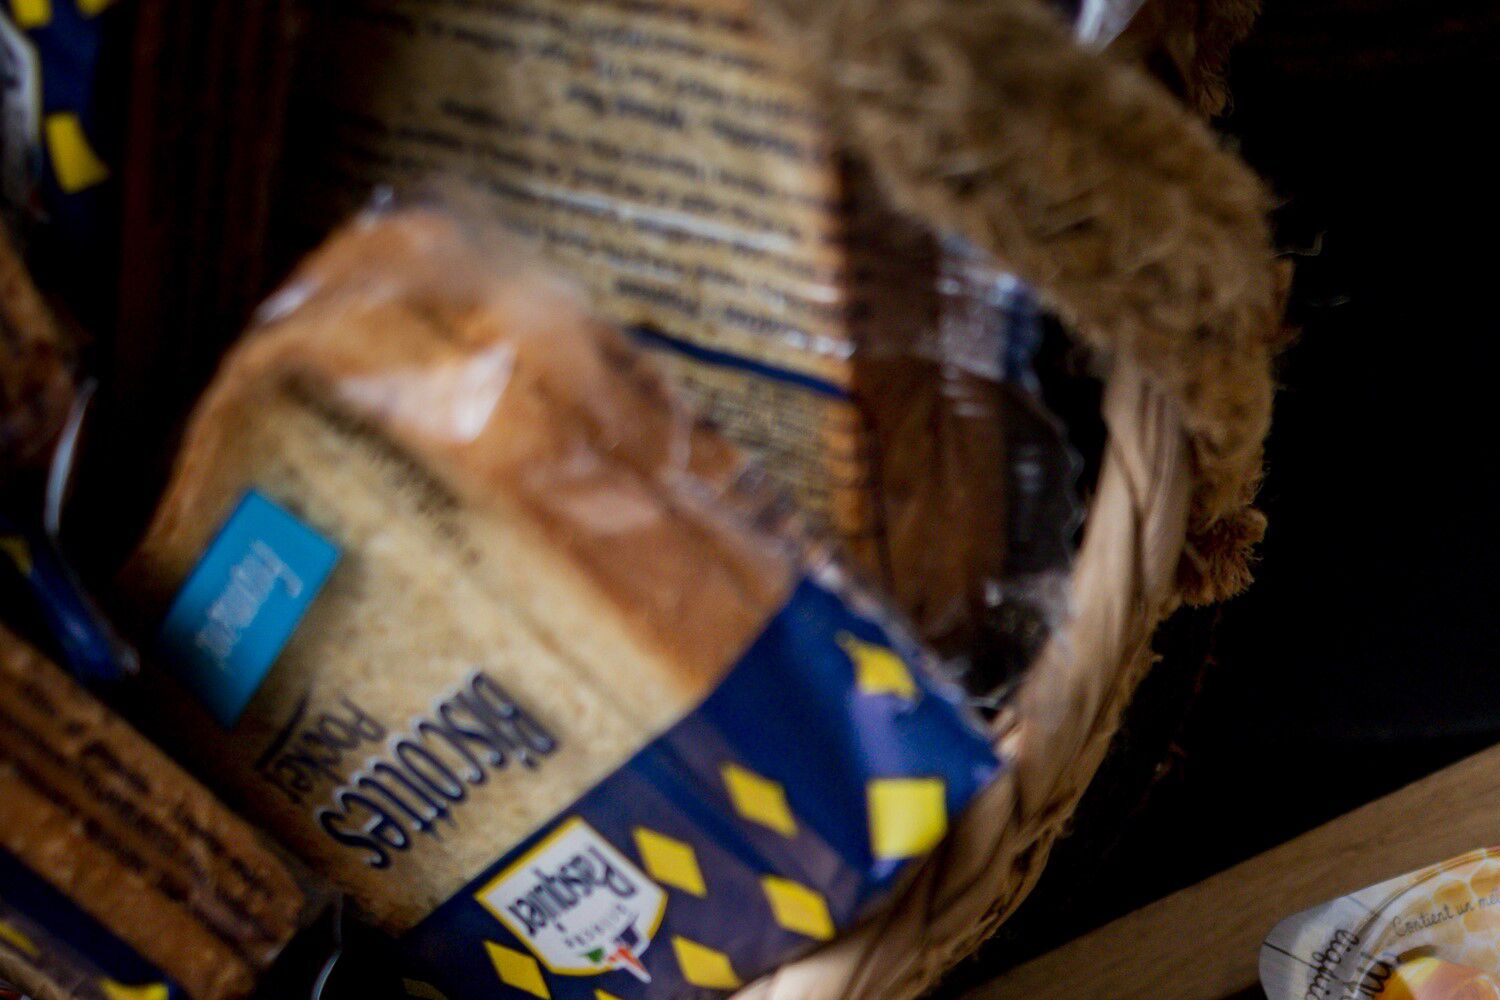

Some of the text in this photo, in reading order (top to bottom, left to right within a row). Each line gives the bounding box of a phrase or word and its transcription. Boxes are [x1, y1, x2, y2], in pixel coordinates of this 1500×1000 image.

[316, 668, 559, 869] Biscottes
[507, 844, 638, 935] Pasquier
[1393, 905, 1454, 937] Contient
